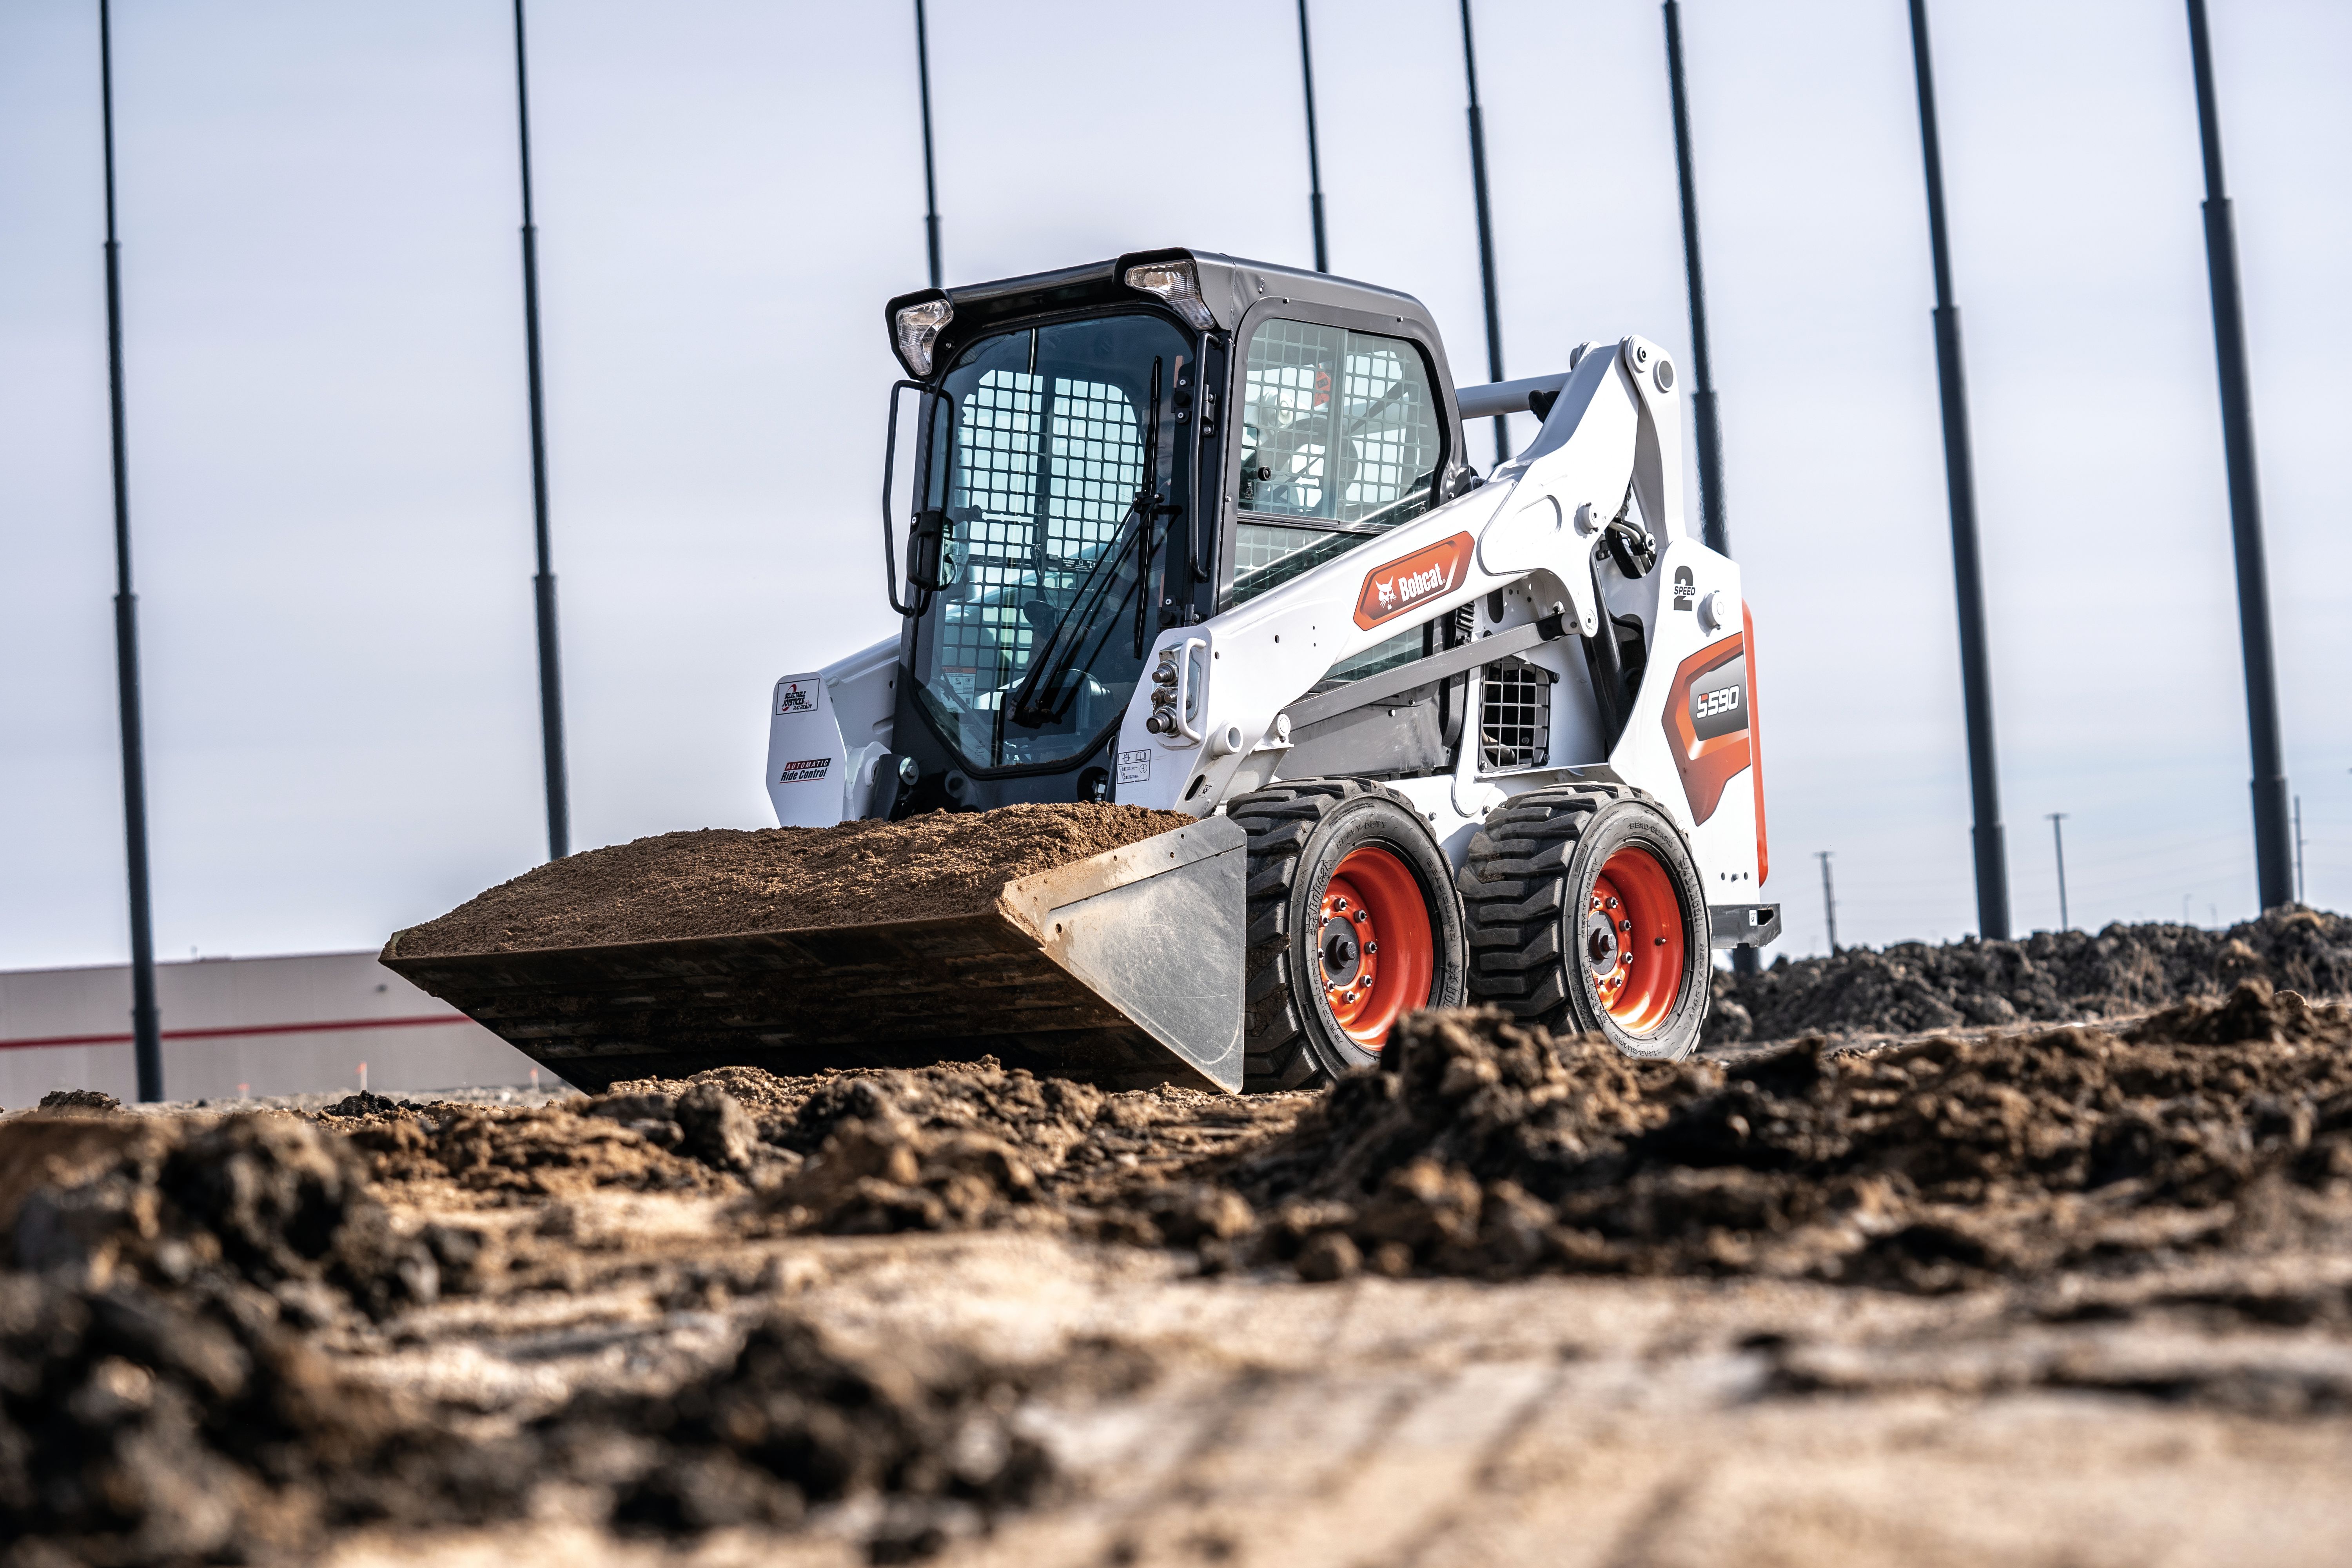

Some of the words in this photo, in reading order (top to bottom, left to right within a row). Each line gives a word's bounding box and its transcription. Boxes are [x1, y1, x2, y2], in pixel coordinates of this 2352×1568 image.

[1398, 563, 1443, 602] Bobcat
[1674, 586, 1695, 595] SPEED
[784, 691, 806, 699] SELECTABLE
[782, 697, 805, 707] JOYSTICKS
[1697, 684, 1740, 719] S590
[786, 760, 828, 770] AUTOMATIC
[780, 771, 799, 781] Ride
[799, 768, 828, 780] Control
